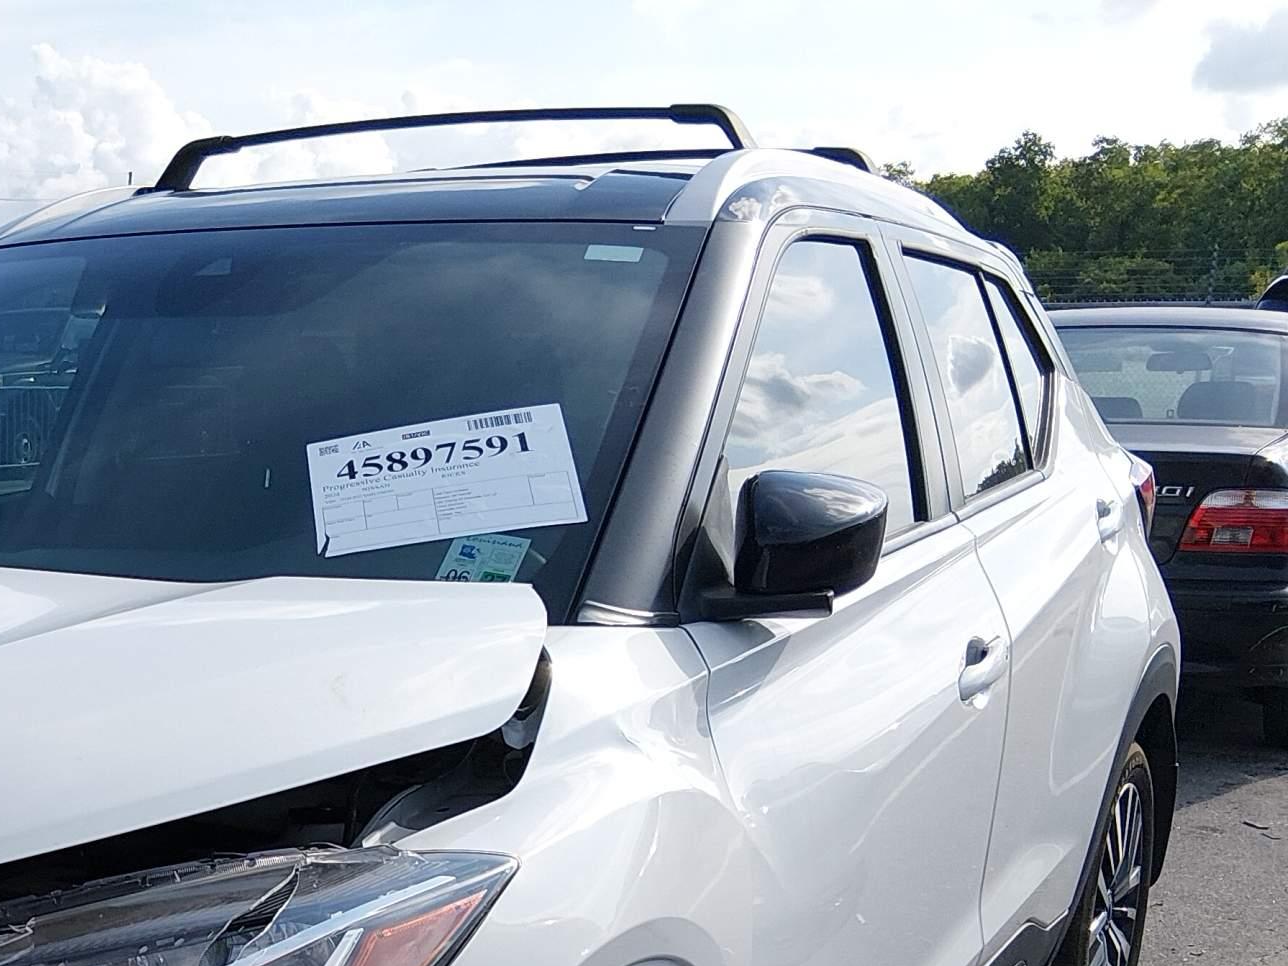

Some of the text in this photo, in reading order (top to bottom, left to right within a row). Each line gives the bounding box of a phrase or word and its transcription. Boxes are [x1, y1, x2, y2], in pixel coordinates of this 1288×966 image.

[322, 460, 480, 493] Progressive Casualty Insurance
[336, 431, 534, 481] 45897591
